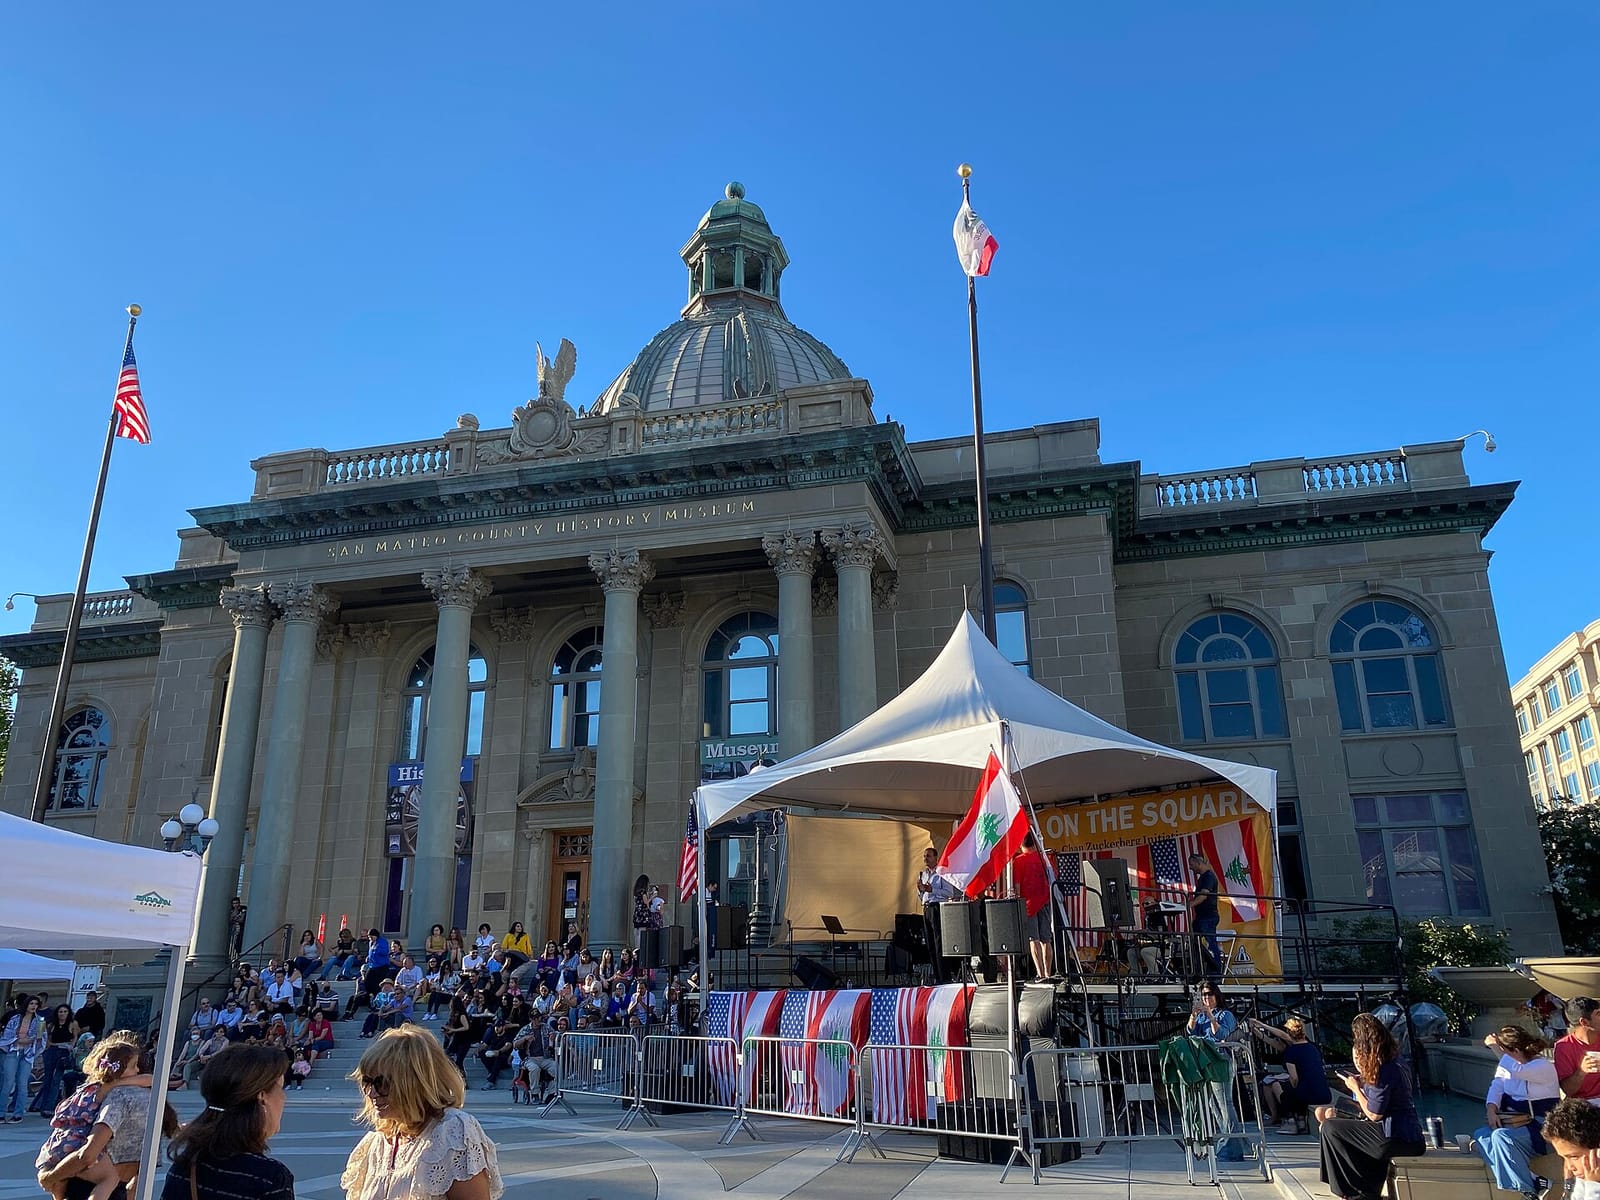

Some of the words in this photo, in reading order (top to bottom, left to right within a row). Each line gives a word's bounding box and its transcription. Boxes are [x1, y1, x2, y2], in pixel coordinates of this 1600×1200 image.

[327, 543, 364, 557] SAN
[376, 535, 446, 553] MATEO
[458, 524, 543, 543] COUNTY
[555, 512, 652, 533] HISTORY
[665, 501, 754, 521] MUSEUM
[1046, 813, 1079, 839] ON
[1086, 805, 1134, 834] THE
